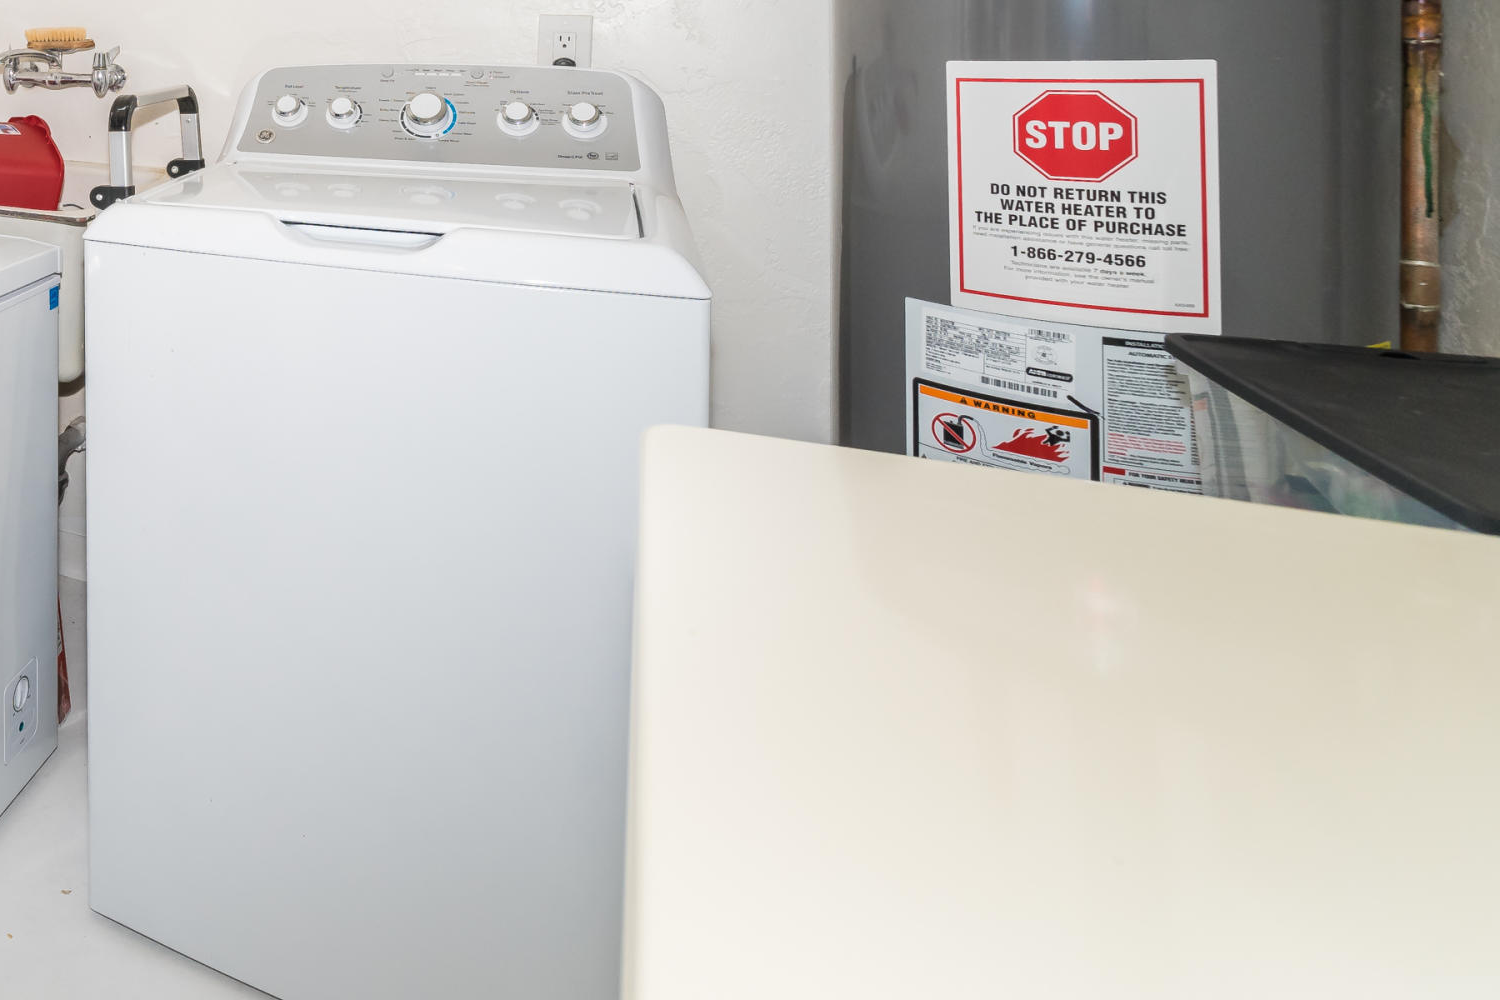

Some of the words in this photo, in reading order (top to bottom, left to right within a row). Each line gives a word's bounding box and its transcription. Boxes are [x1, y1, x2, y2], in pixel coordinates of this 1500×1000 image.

[1025, 120, 1123, 150] STOP
[990, 183, 1010, 196] DO
[1016, 184, 1048, 199] NOT
[1053, 187, 1121, 203] RETURN
[1128, 191, 1167, 205] THIS
[1000, 199, 1055, 214] WATER
[1061, 203, 1127, 219] HEATER
[1134, 207, 1156, 220] TO
[975, 211, 1003, 225] THE
[1008, 214, 1060, 230] PLACE
[1066, 219, 1087, 232] OF
[1094, 221, 1187, 237] PURCHASE
[1010, 245, 1146, 268] 1-866-279-4566
[973, 401, 1036, 419] WARNING
